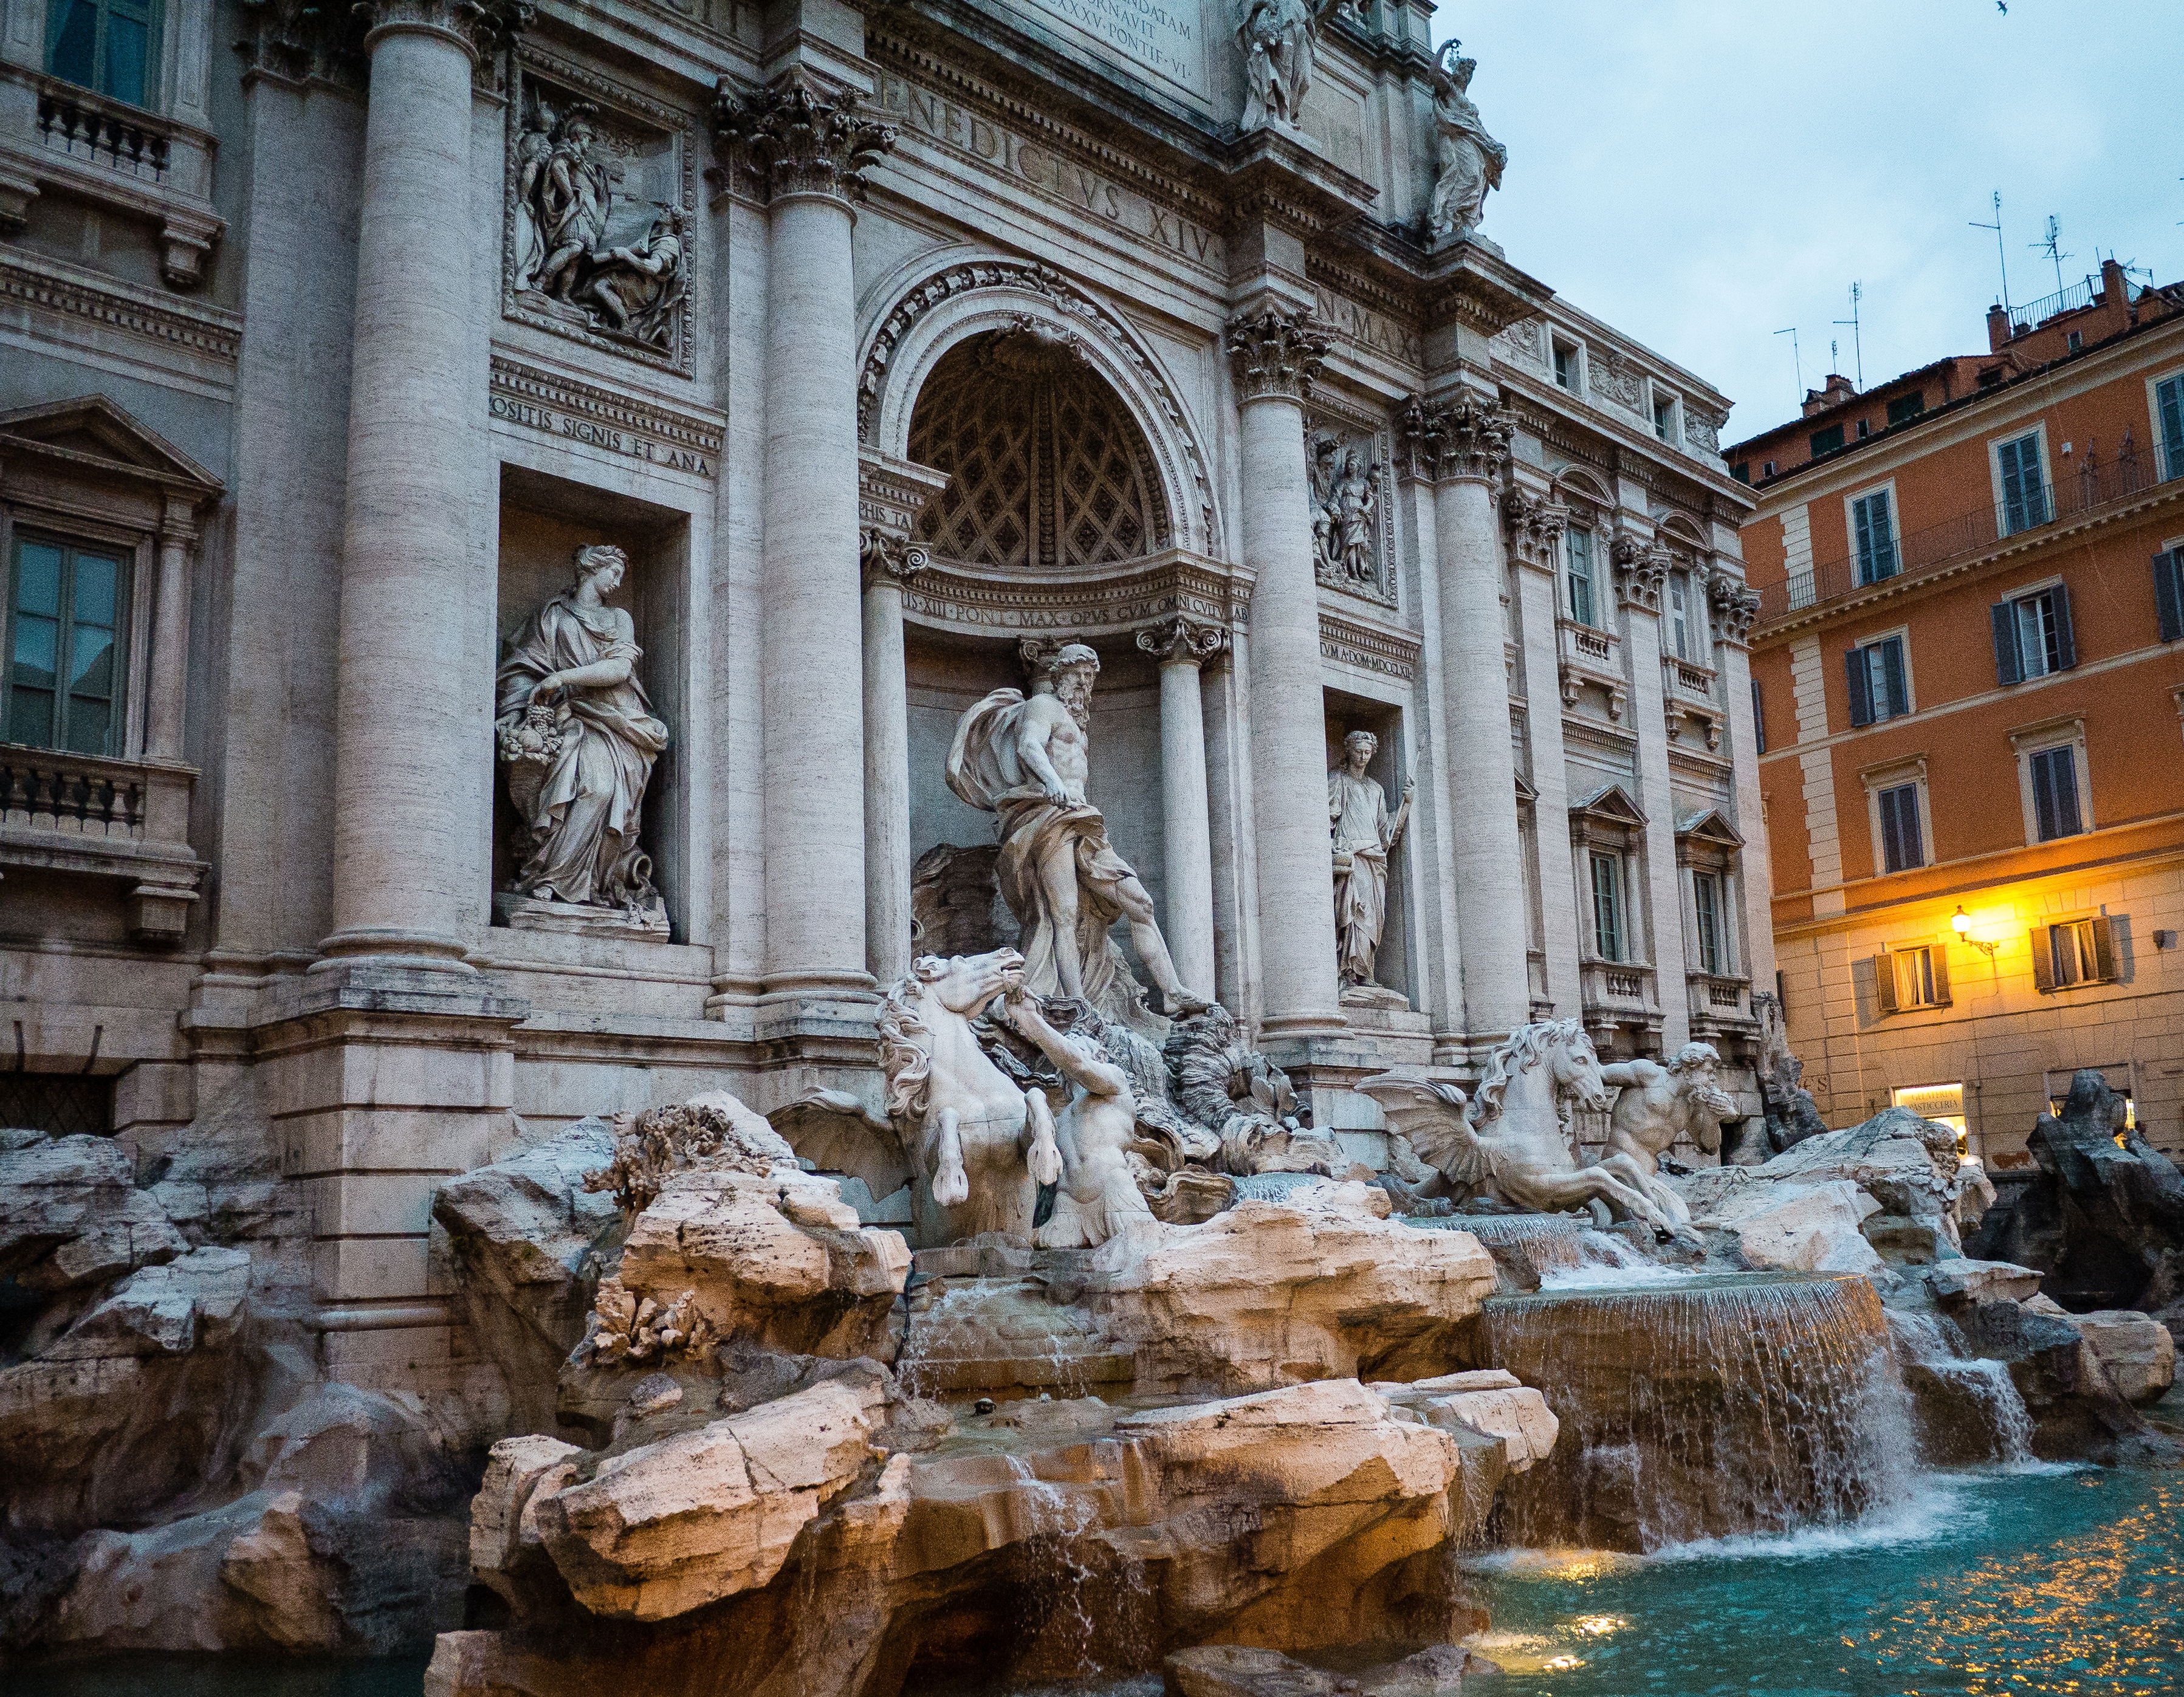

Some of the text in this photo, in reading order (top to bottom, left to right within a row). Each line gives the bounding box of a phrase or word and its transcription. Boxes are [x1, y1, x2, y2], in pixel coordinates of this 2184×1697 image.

[490, 396, 710, 476] OSITIS SIGNIS ET ANA
[892, 510, 910, 529] TA
[1070, 609, 1109, 625] OPVS
[1117, 602, 1152, 620] CVM
[1158, 594, 1190, 612] OMNI
[1234, 606, 1248, 621] AB
